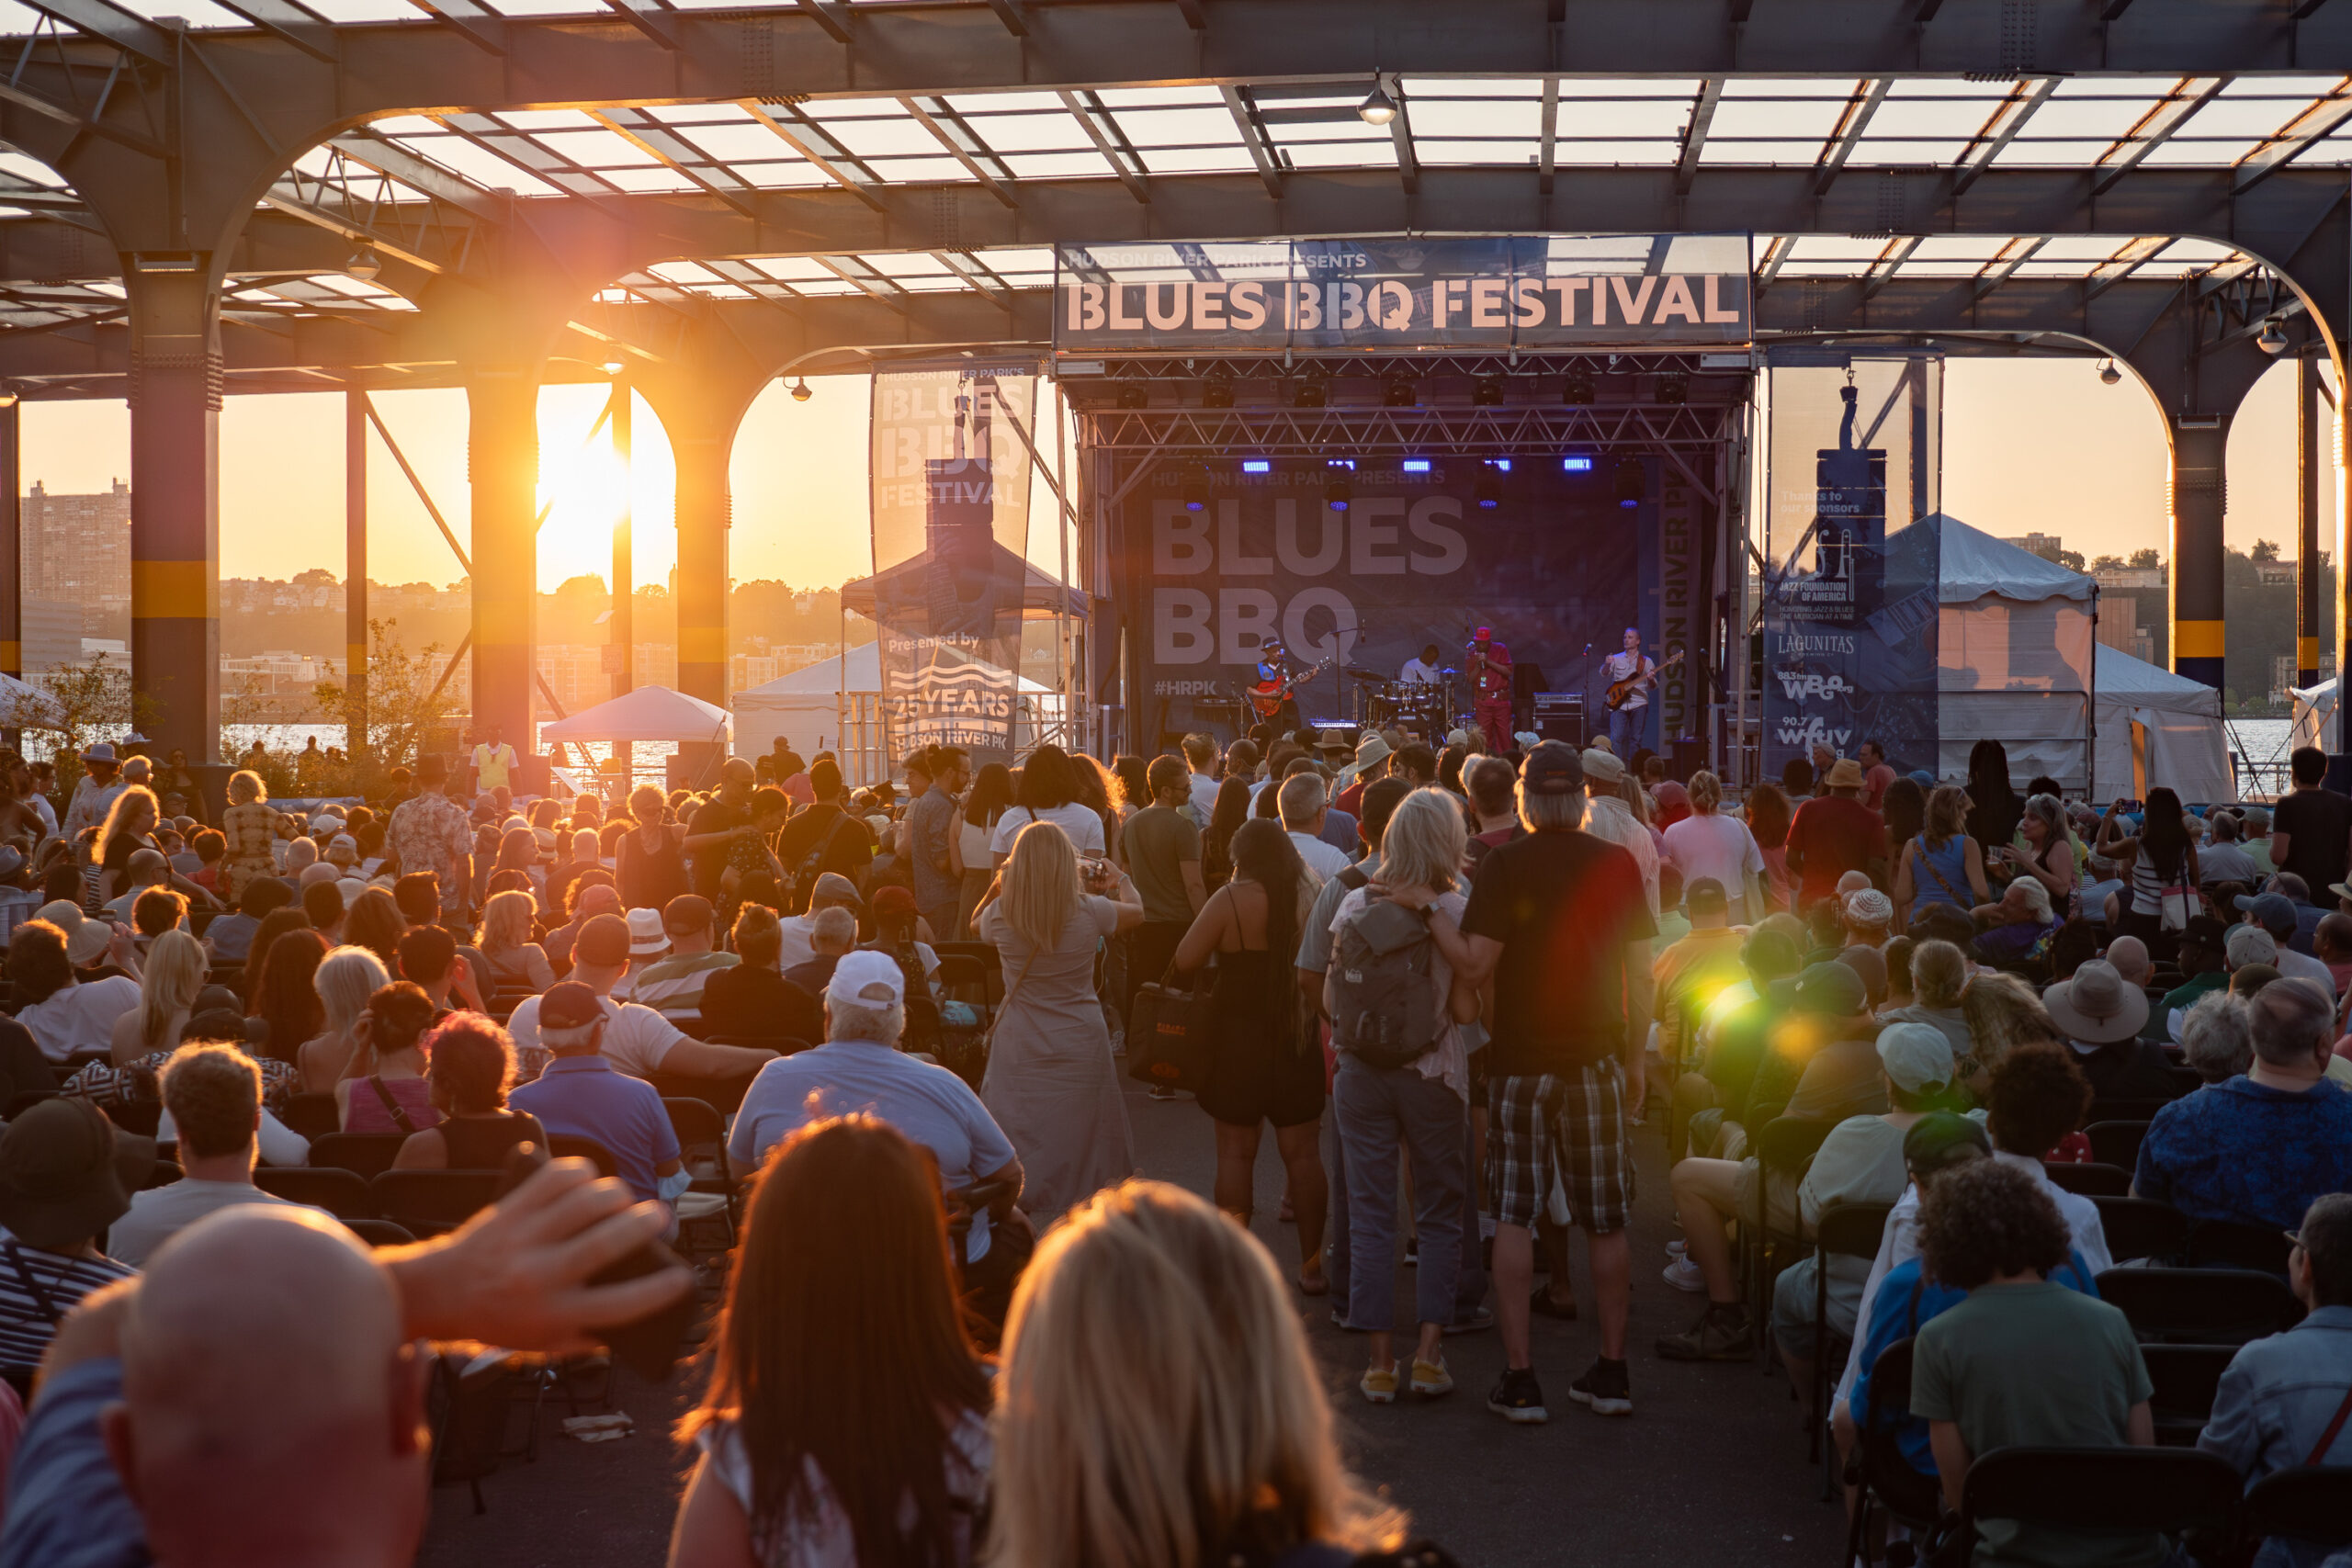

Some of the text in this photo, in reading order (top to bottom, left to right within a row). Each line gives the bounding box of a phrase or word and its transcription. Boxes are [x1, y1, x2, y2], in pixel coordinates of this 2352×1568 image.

[1069, 253, 1366, 268] HUDSON RIVER PARK PRESENTS
[1068, 276, 1739, 333] BLUES BBQ FESTIVAL
[884, 367, 1025, 383] HUDSON RIVER PARK'S
[883, 384, 1024, 422] BLUES
[881, 423, 1023, 480] BBQ
[1235, 471, 1289, 485] RIVER
[881, 481, 1022, 508] FESTIVAL
[1781, 490, 1843, 502] Thanks to
[1781, 504, 1860, 515] our sponsors
[1152, 496, 1468, 576] BLUES
[1664, 517, 1688, 607] RIVER
[1779, 581, 1847, 592] JAZZ FOUNDATION
[1802, 592, 1847, 602] OF AMERICA
[1153, 587, 1358, 667] BBQ
[888, 632, 979, 652] Presented by
[1778, 635, 1854, 655] LAGUNITAS
[1154, 680, 1217, 696] #HRPK
[1664, 617, 1687, 745] HUDSON
[893, 689, 1010, 719] 25 YEARS
[1782, 716, 1808, 727] 90.7
[895, 730, 1008, 751] HUDSON RIVER PK
